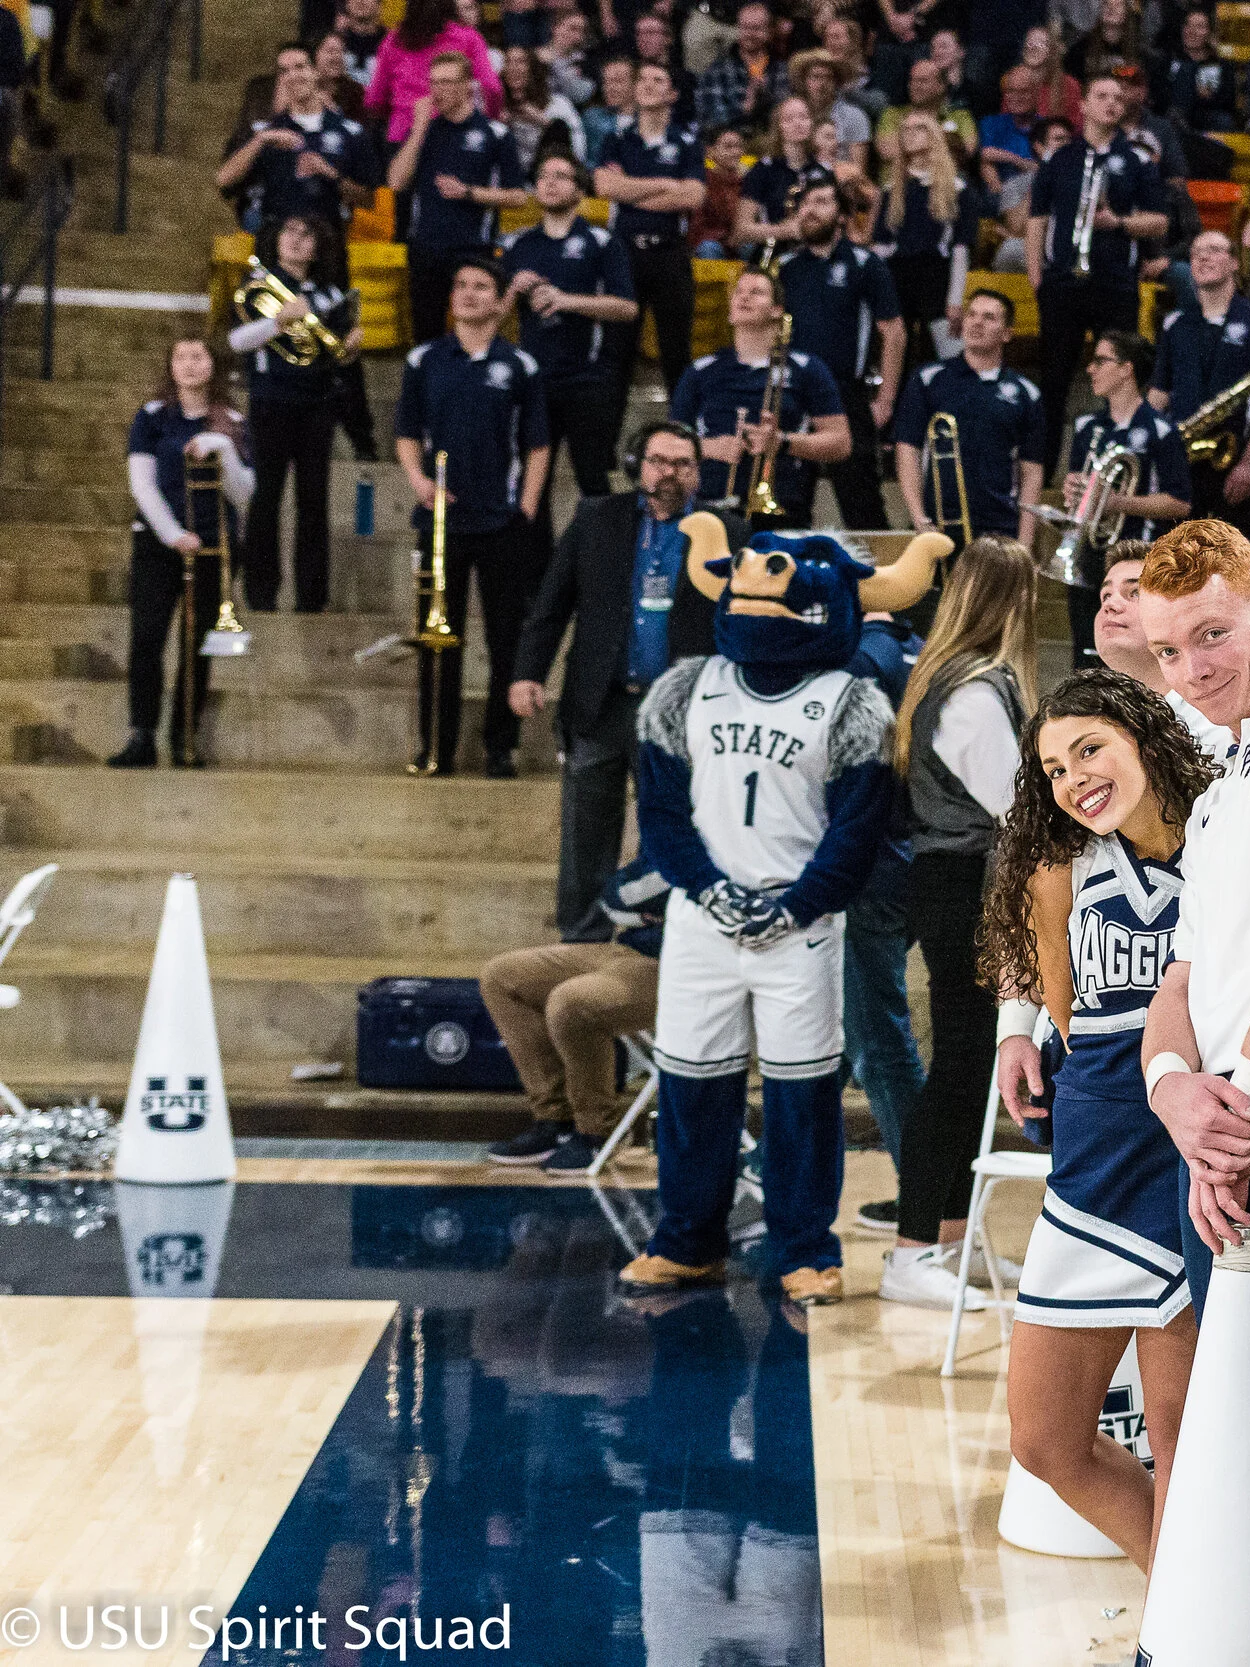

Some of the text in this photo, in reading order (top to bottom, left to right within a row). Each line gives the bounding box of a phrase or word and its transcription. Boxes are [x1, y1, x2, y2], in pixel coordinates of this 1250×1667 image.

[710, 723, 806, 769] STATE
[744, 770, 759, 828] 1
[1078, 906, 1177, 998] AGGI
